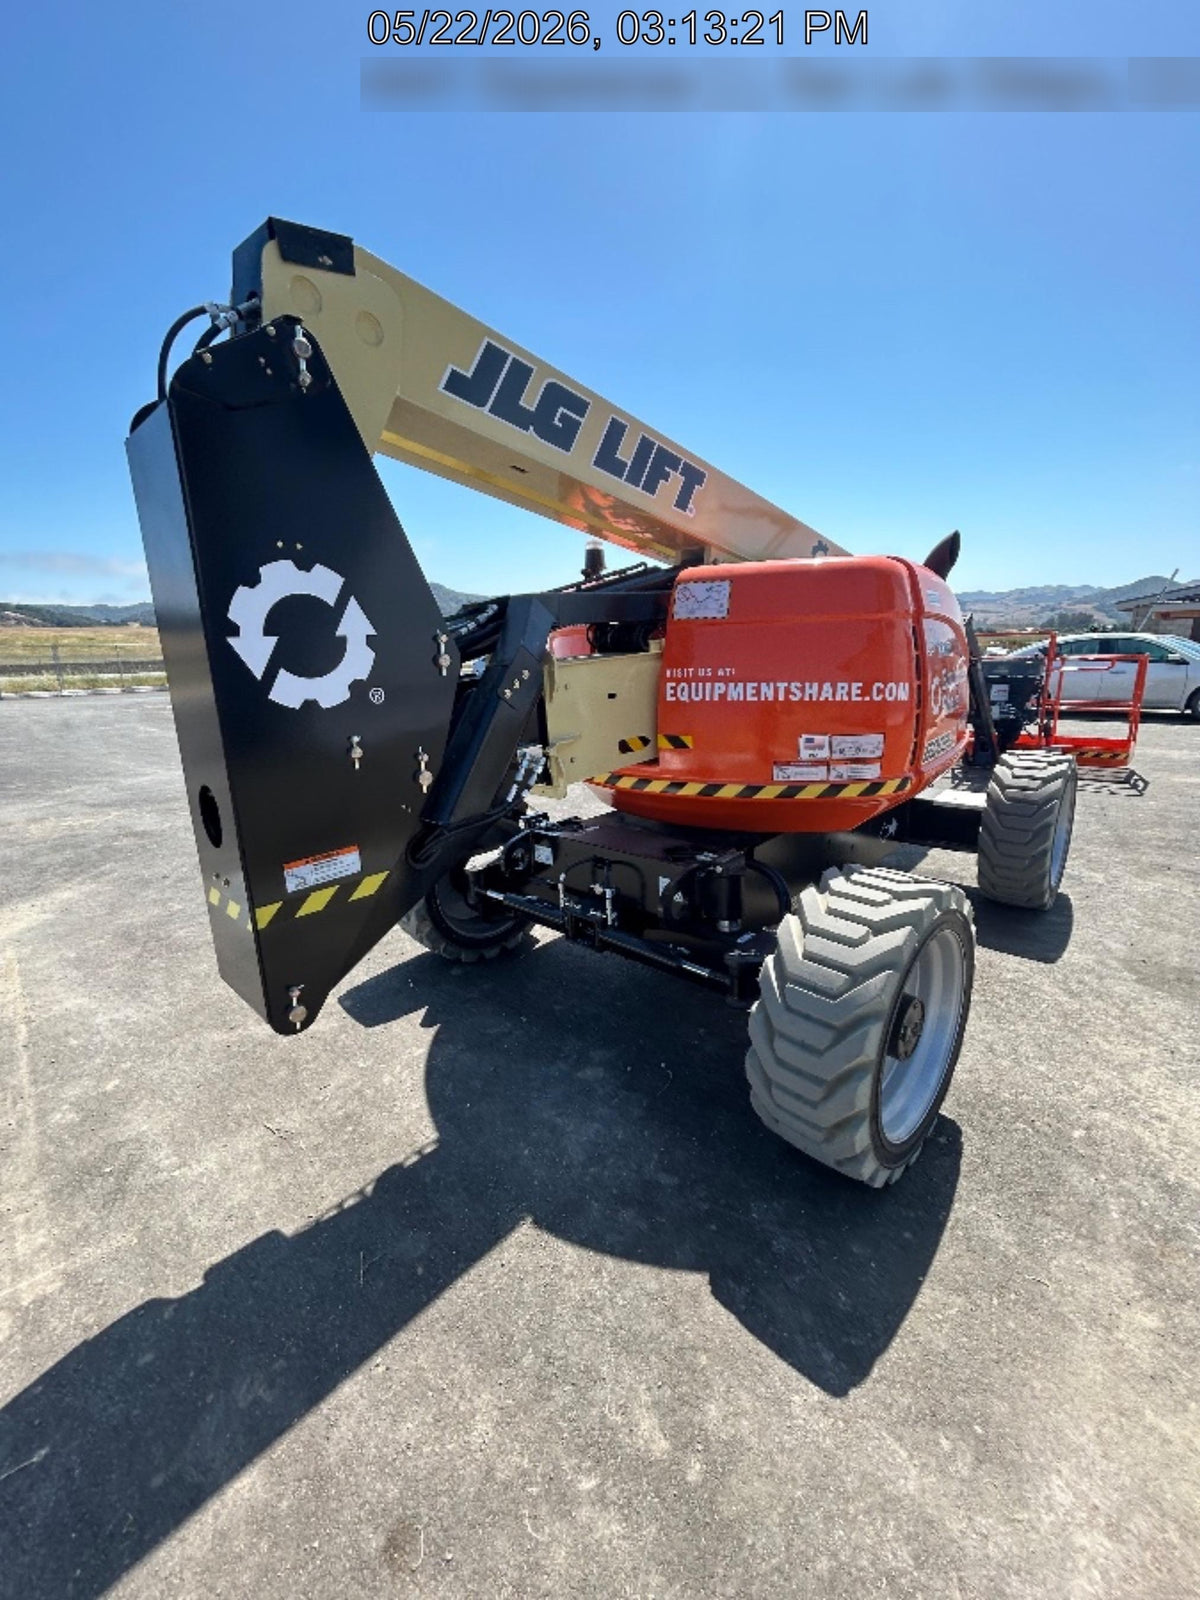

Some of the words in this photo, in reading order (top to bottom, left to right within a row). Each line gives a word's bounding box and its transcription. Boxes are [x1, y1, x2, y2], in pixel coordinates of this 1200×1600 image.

[438, 336, 592, 454] JLG
[591, 414, 708, 513] LIFT
[666, 668, 694, 677] VISIT
[698, 668, 712, 677] US
[717, 668, 735, 677] AT:
[666, 682, 910, 702] EQUIPMENTSHARE.COM
